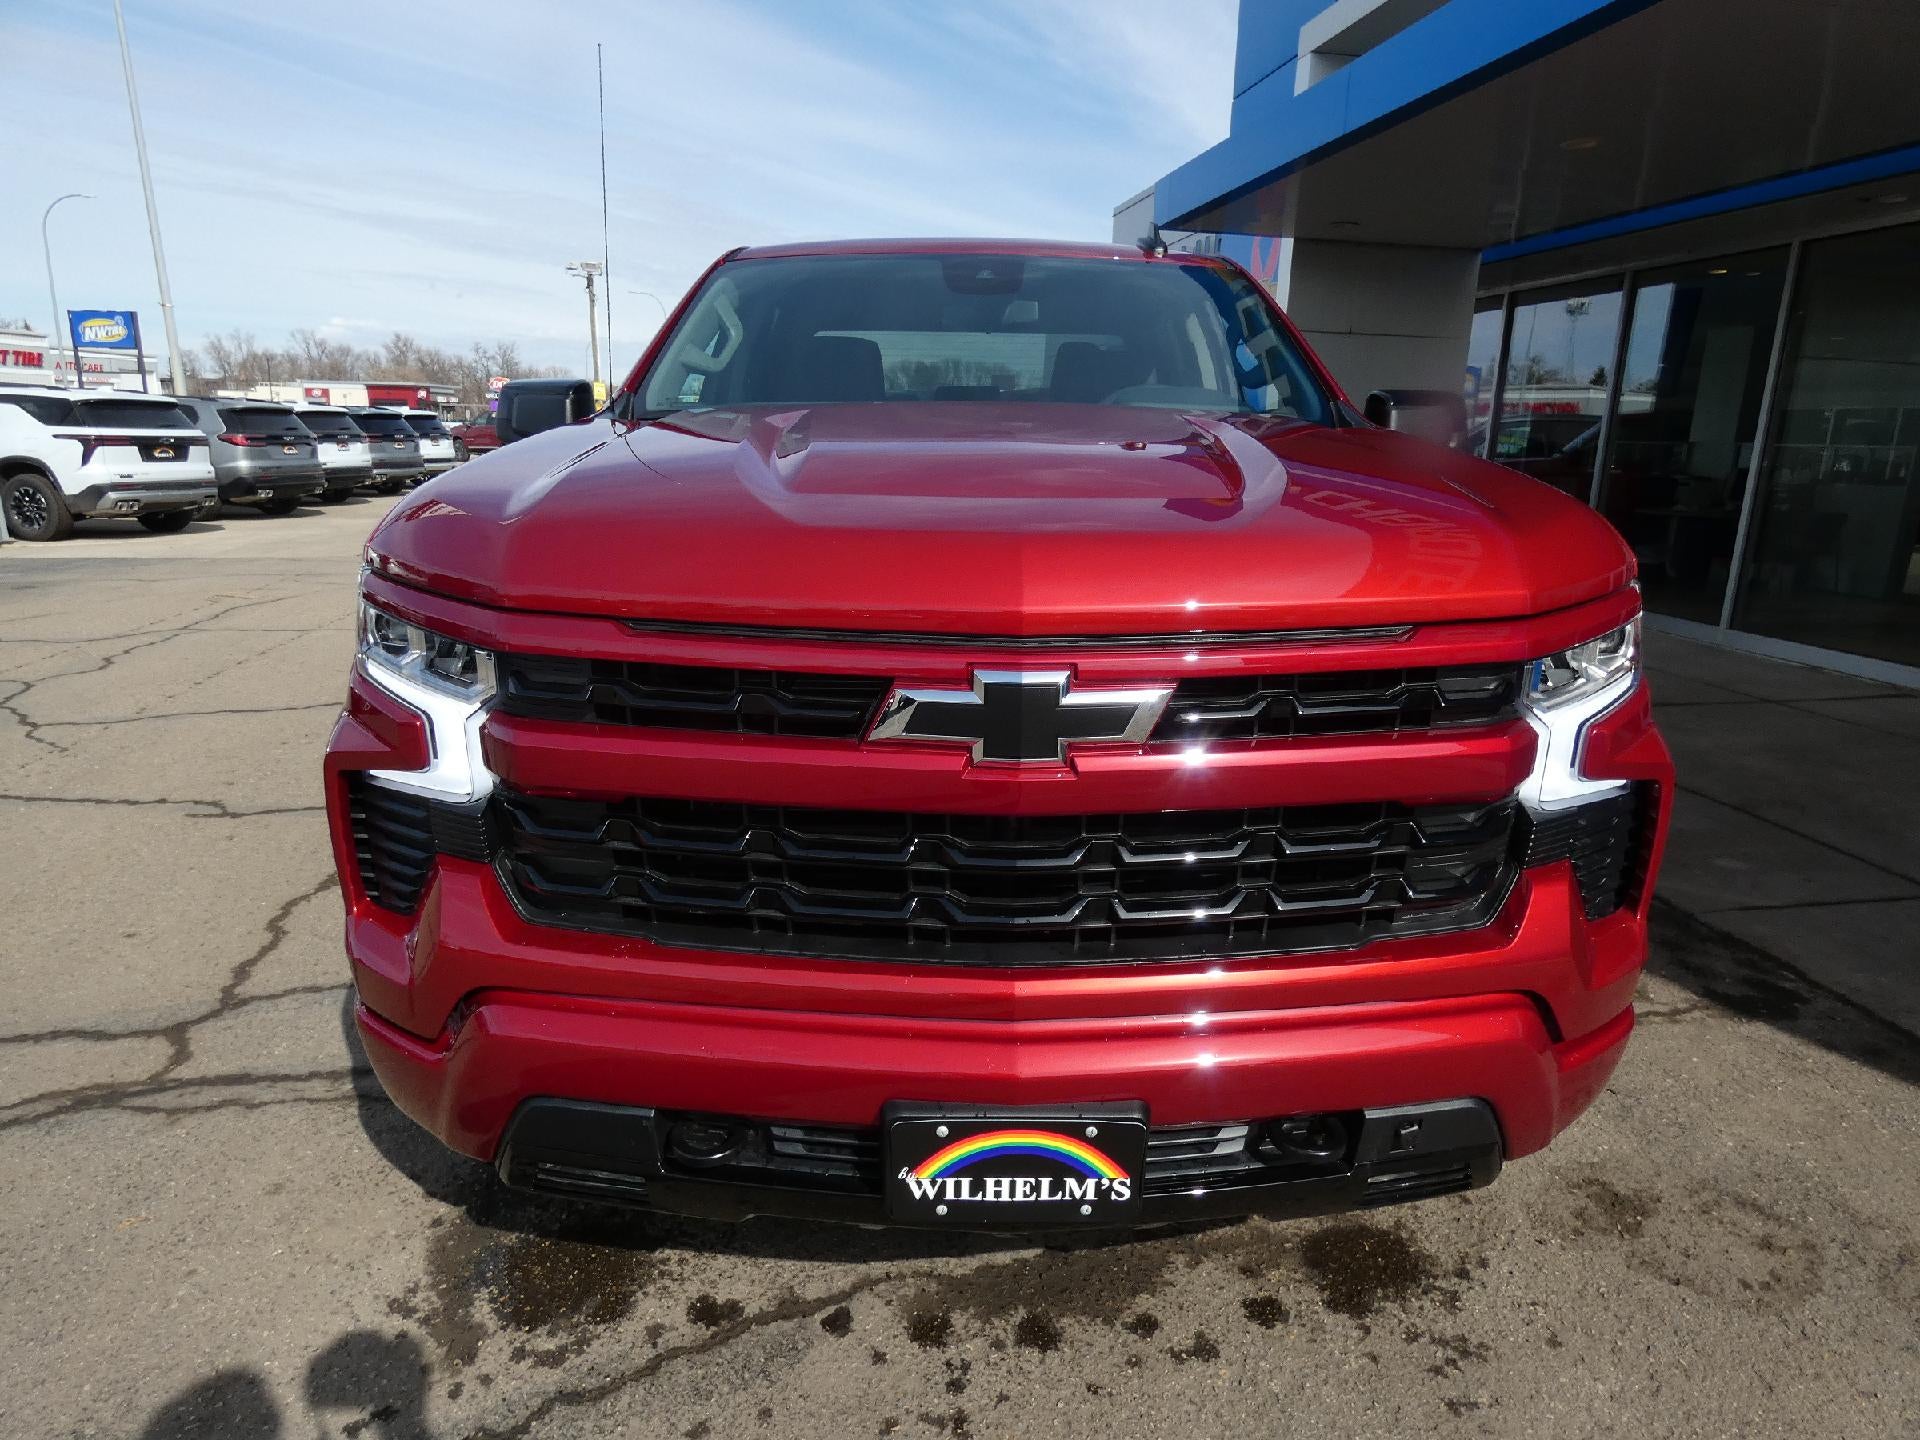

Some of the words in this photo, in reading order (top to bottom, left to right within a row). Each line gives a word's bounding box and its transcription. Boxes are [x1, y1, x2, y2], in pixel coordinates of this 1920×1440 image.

[12, 350, 44, 368] TIRE
[897, 1166, 917, 1183] by
[905, 1177, 1132, 1202] WILHELM'S
